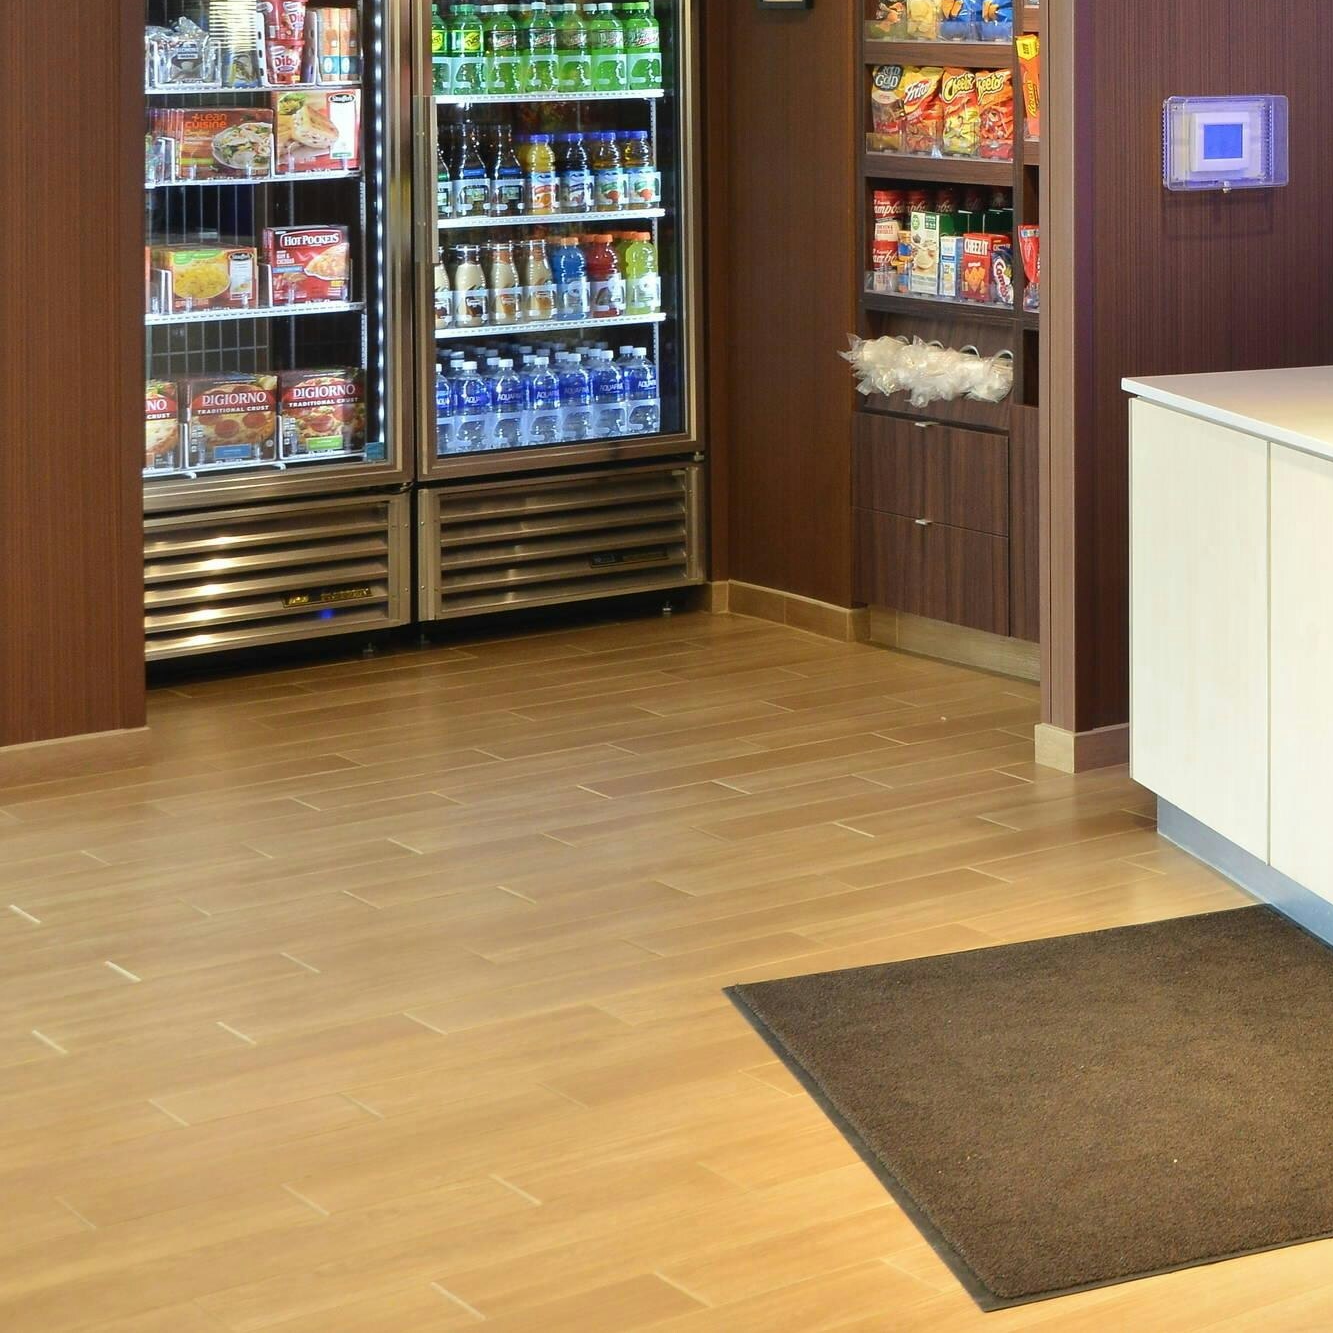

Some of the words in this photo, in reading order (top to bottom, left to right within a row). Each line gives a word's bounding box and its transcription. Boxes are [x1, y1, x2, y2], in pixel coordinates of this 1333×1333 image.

[284, 236, 302, 246] HOT
[303, 233, 339, 245] POCKETS
[336, 397, 359, 405] CRUST
